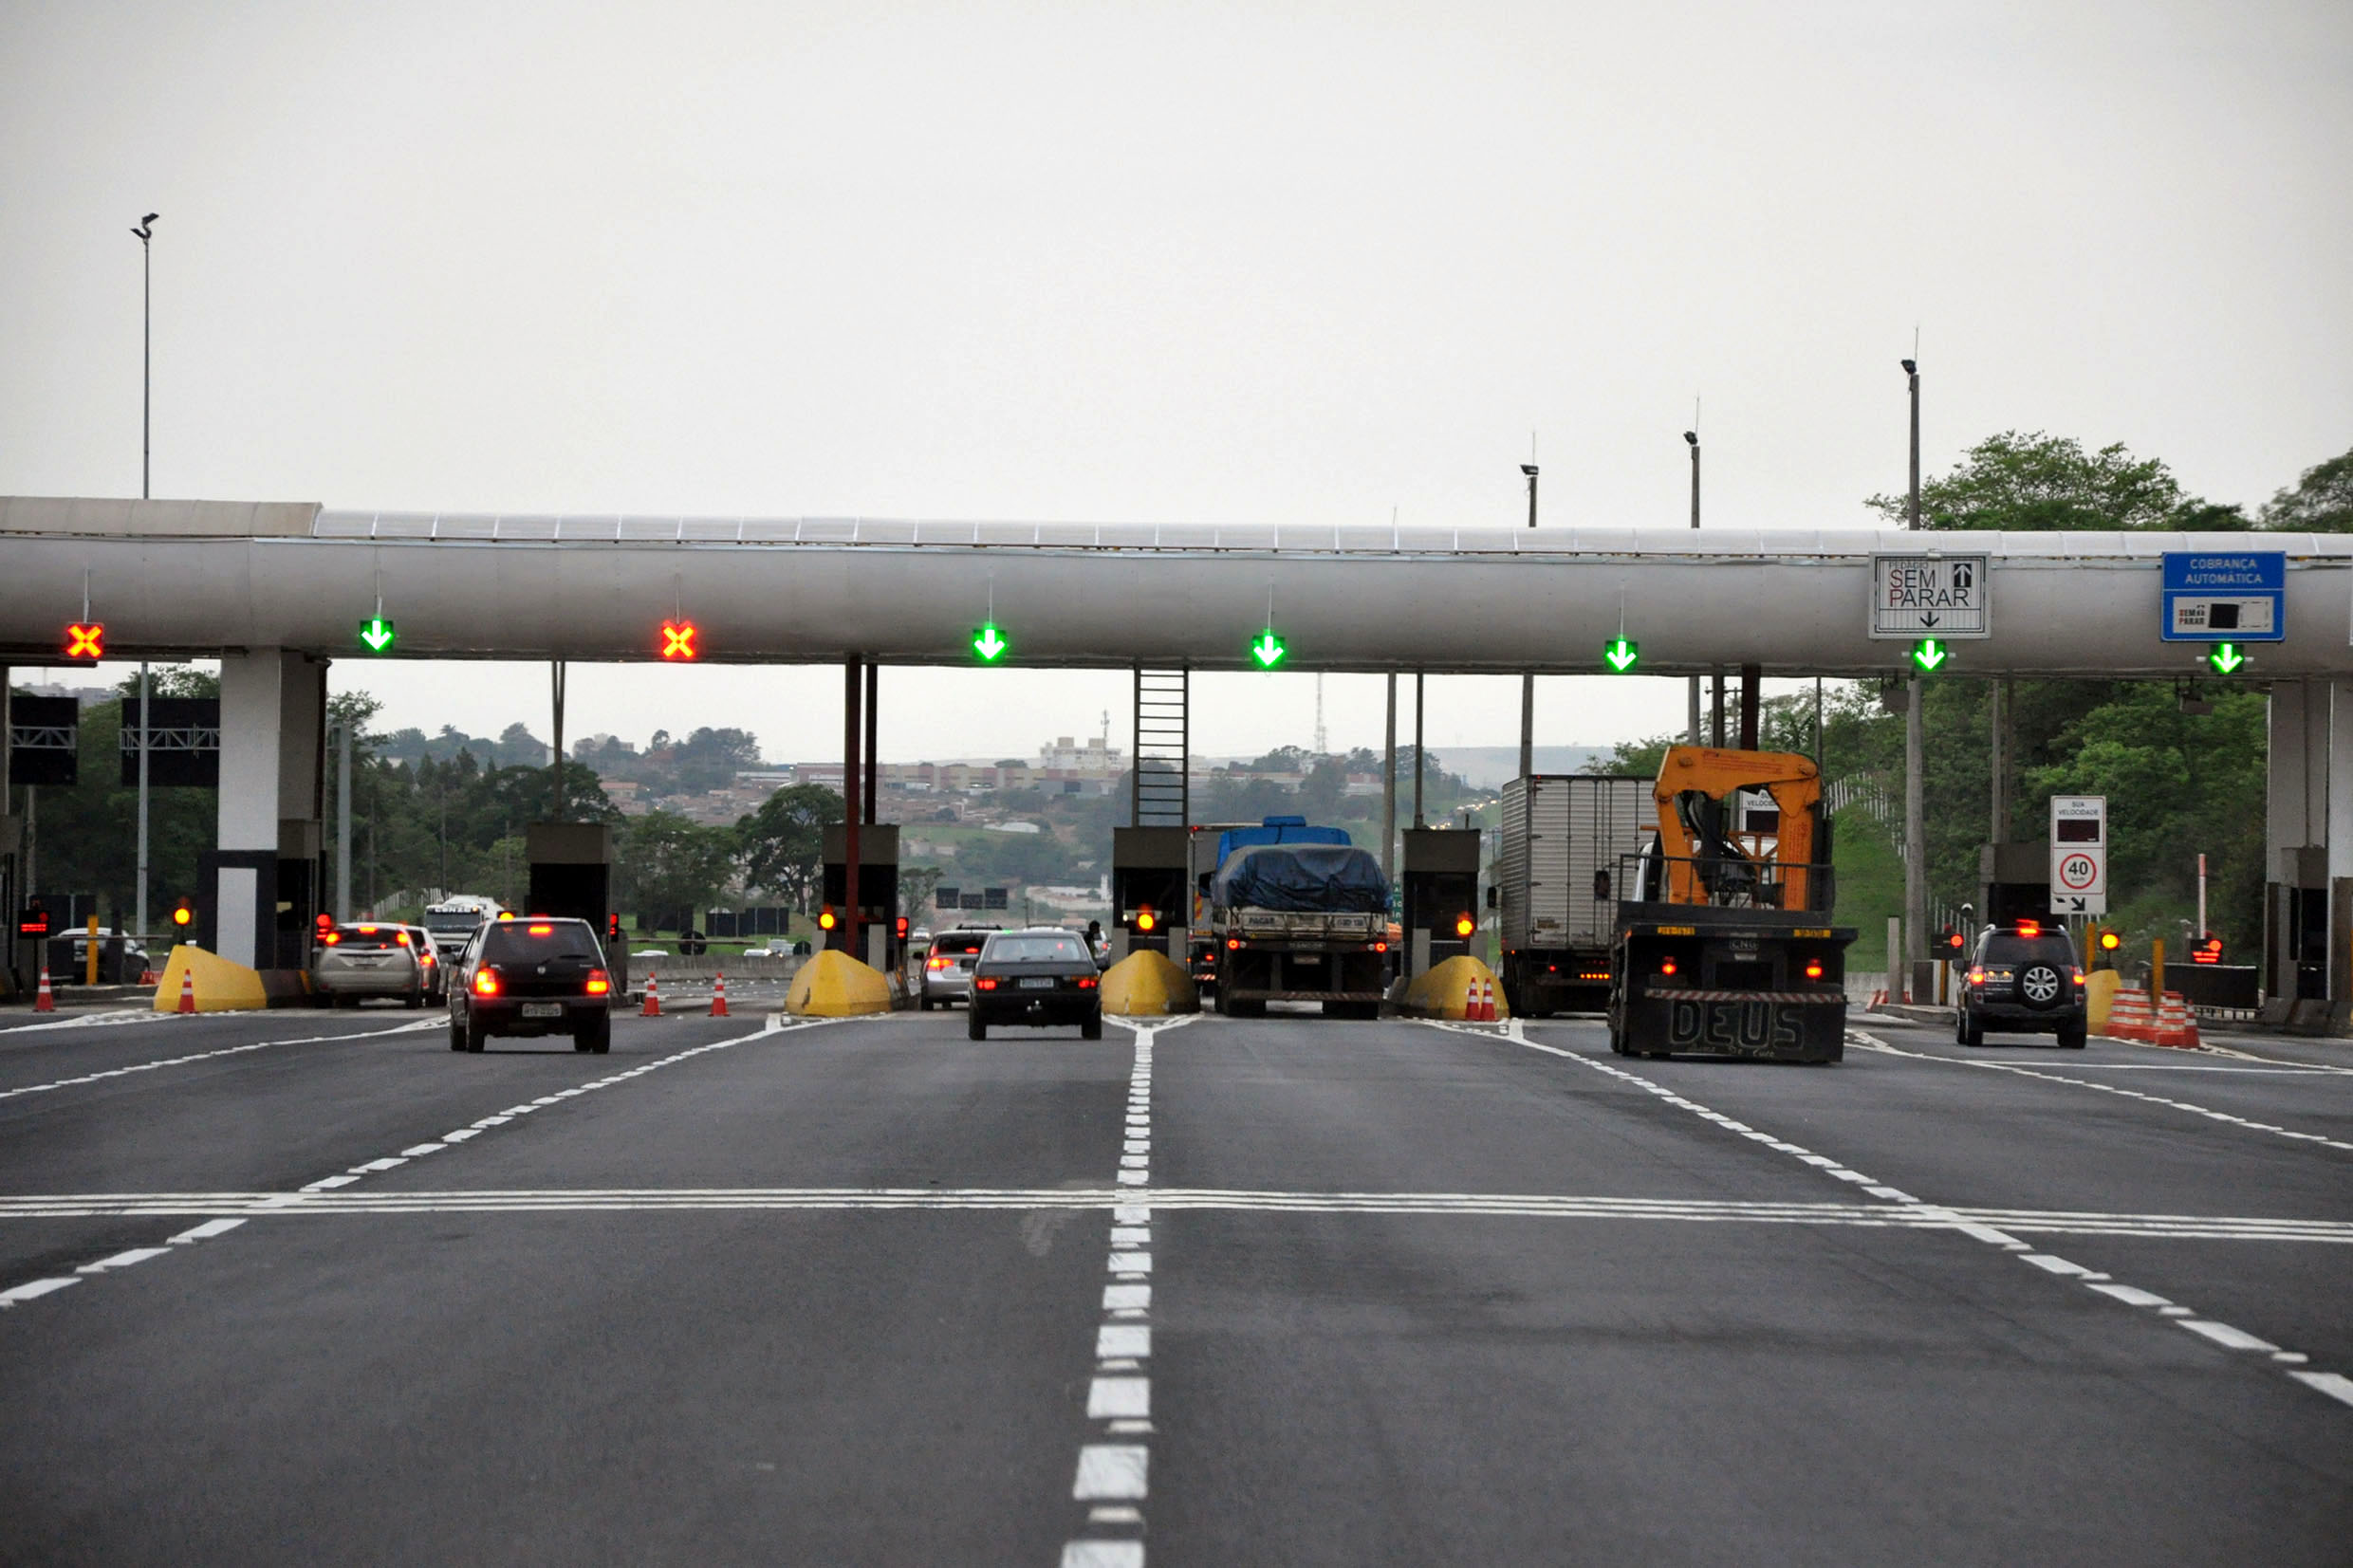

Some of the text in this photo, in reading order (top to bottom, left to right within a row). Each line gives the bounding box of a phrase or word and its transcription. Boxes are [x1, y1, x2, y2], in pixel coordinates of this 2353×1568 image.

[2190, 558, 2257, 571] COBRANÇA
[1890, 569, 1936, 588] SEM
[2185, 571, 2263, 584] AUTOMÁTICA
[1890, 589, 1970, 607] PARAR
[2068, 861, 2088, 875] 40
[1671, 1000, 1804, 1049] DEUS
